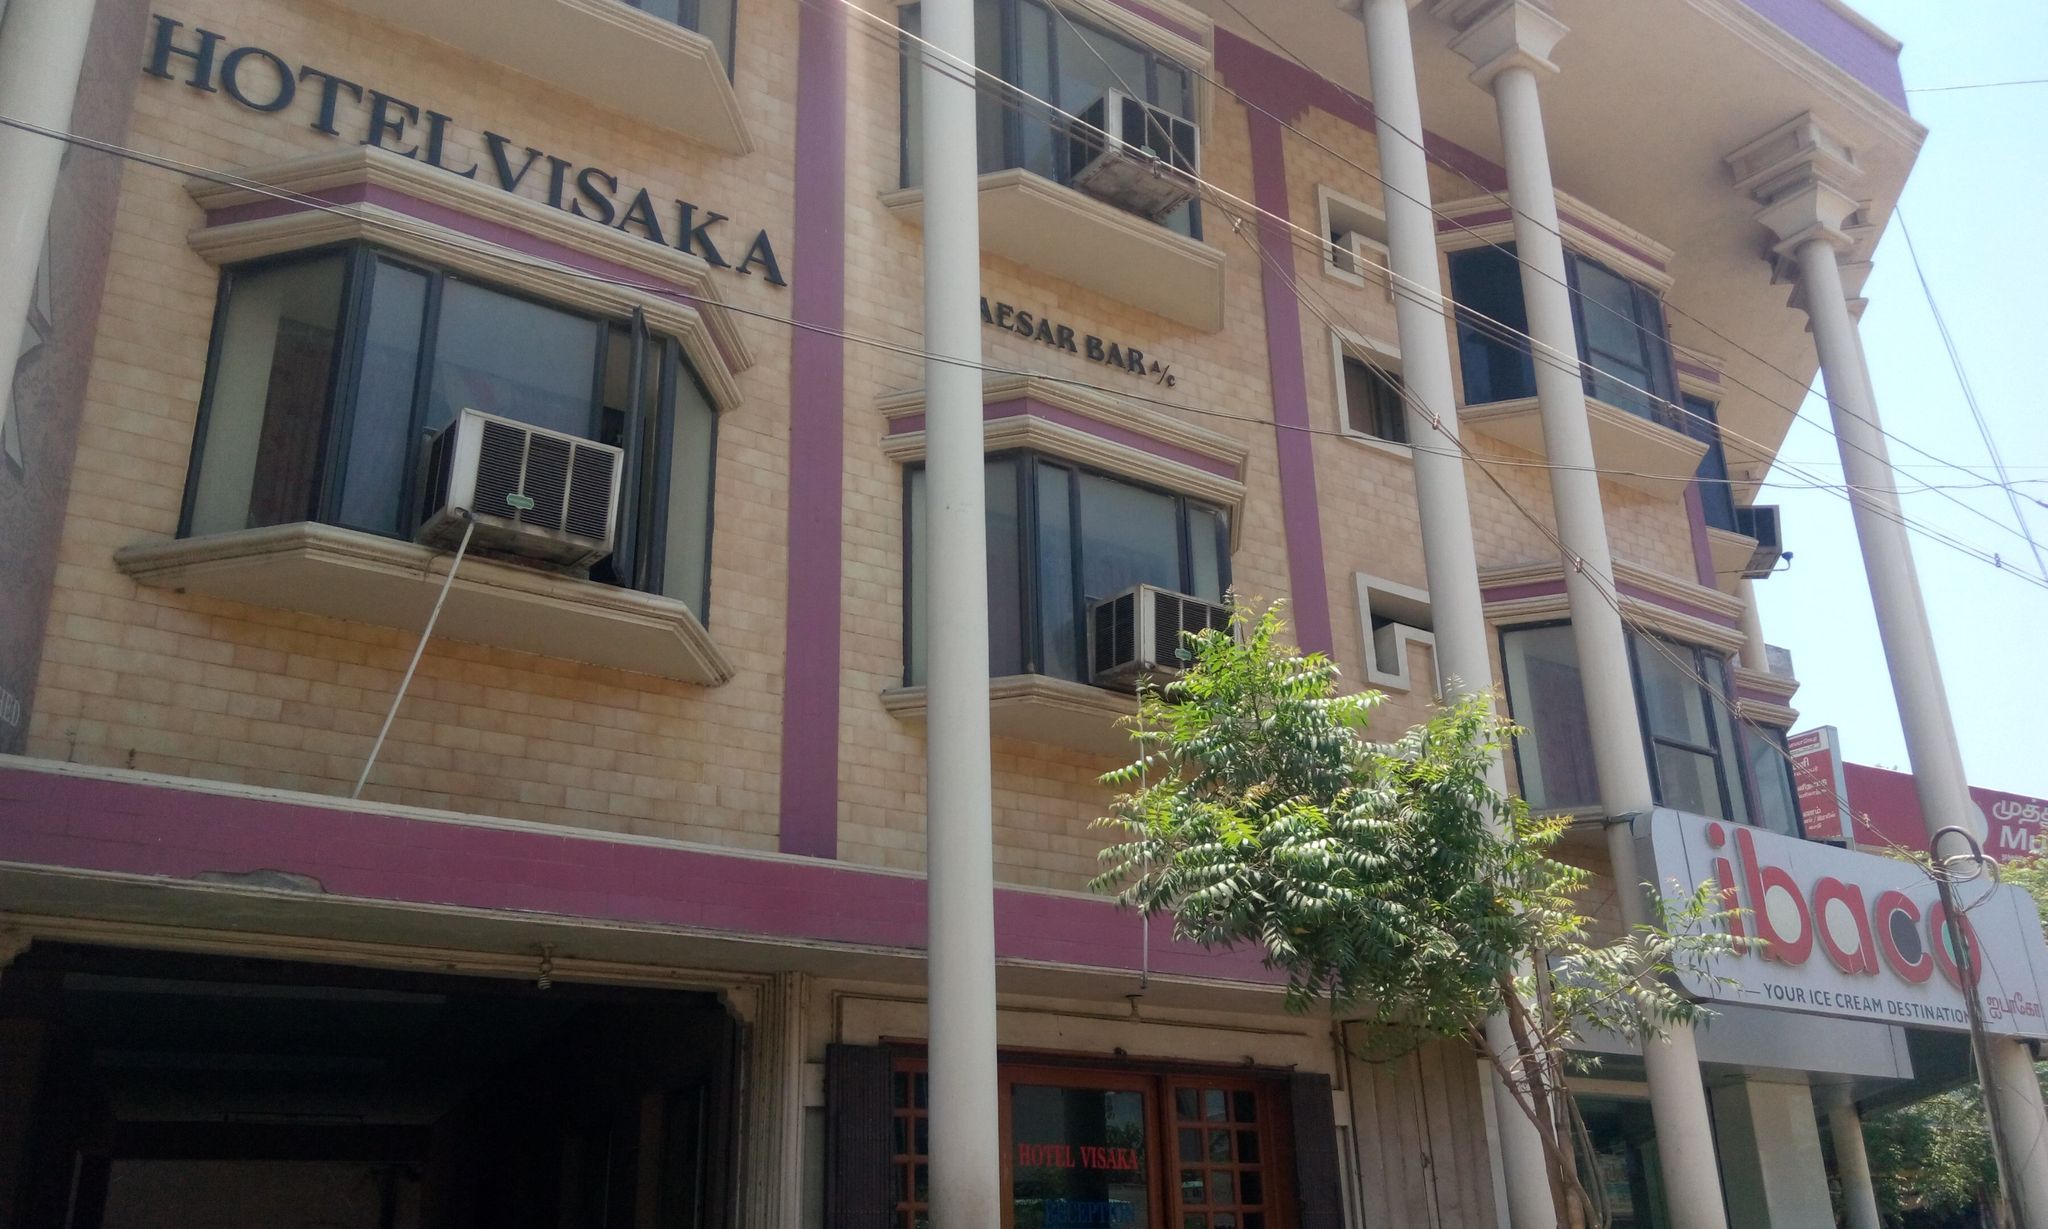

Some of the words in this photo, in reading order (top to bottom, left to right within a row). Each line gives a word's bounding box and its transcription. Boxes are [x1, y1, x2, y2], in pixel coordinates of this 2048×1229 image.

[1085, 334, 1147, 376] BAR
[1706, 821, 1982, 990] ibaco
[1763, 983, 1806, 1004] YOUR
[1809, 990, 1832, 1006] ICE
[1835, 993, 1883, 1014] CREAM
[1018, 1142, 1075, 1169] HOTEL
[1080, 1144, 1139, 1170] VISAKA
